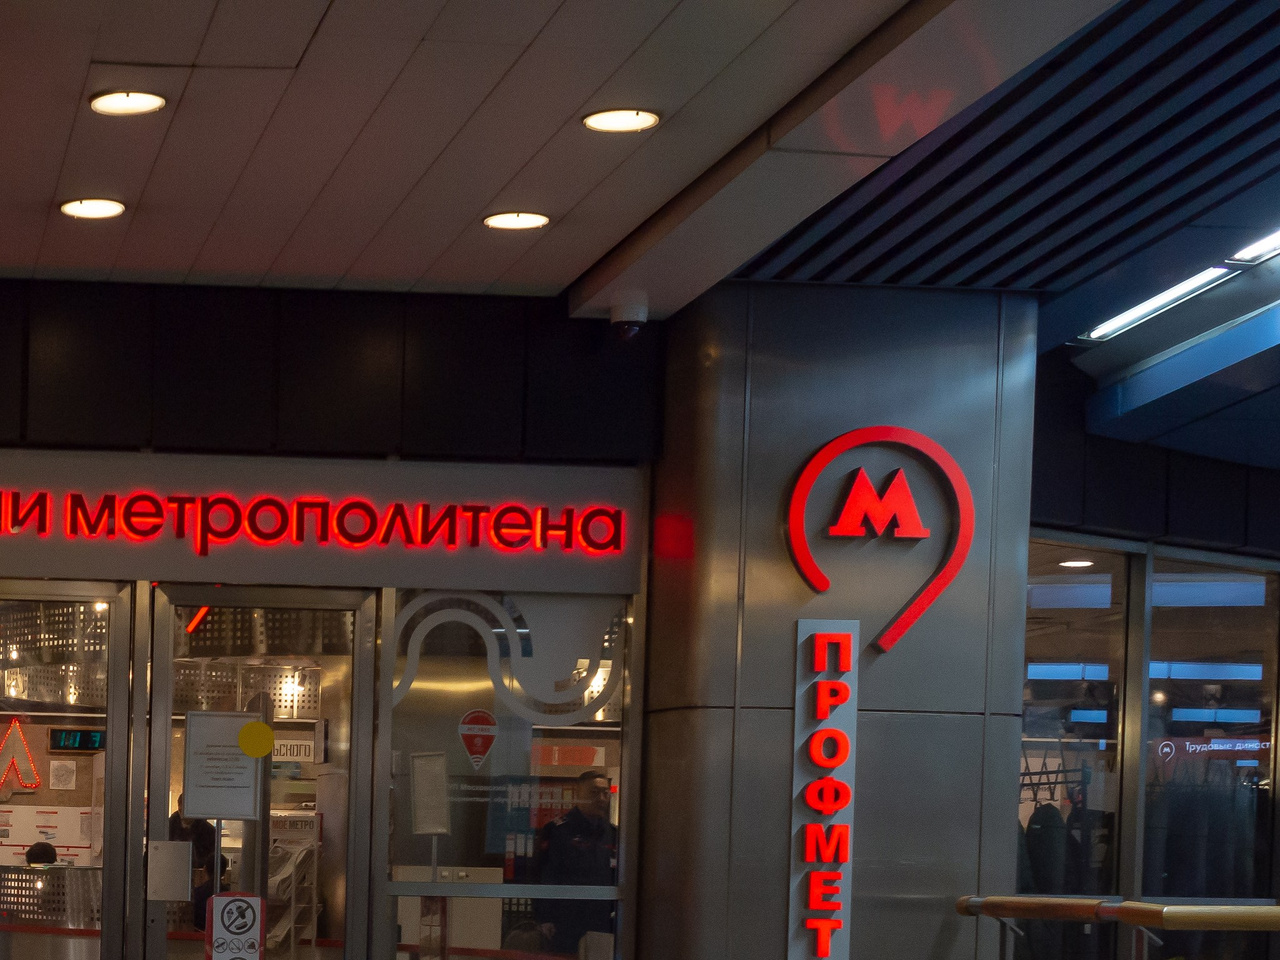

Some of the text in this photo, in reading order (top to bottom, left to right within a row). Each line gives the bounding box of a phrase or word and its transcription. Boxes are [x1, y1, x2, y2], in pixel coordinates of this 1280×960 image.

[67, 490, 623, 556] метрополитена
[273, 744, 311, 757] ЬСКОГО
[1185, 742, 1232, 753] Трудовые
[1235, 741, 1271, 751] династ
[288, 820, 315, 830] МЕТРО
